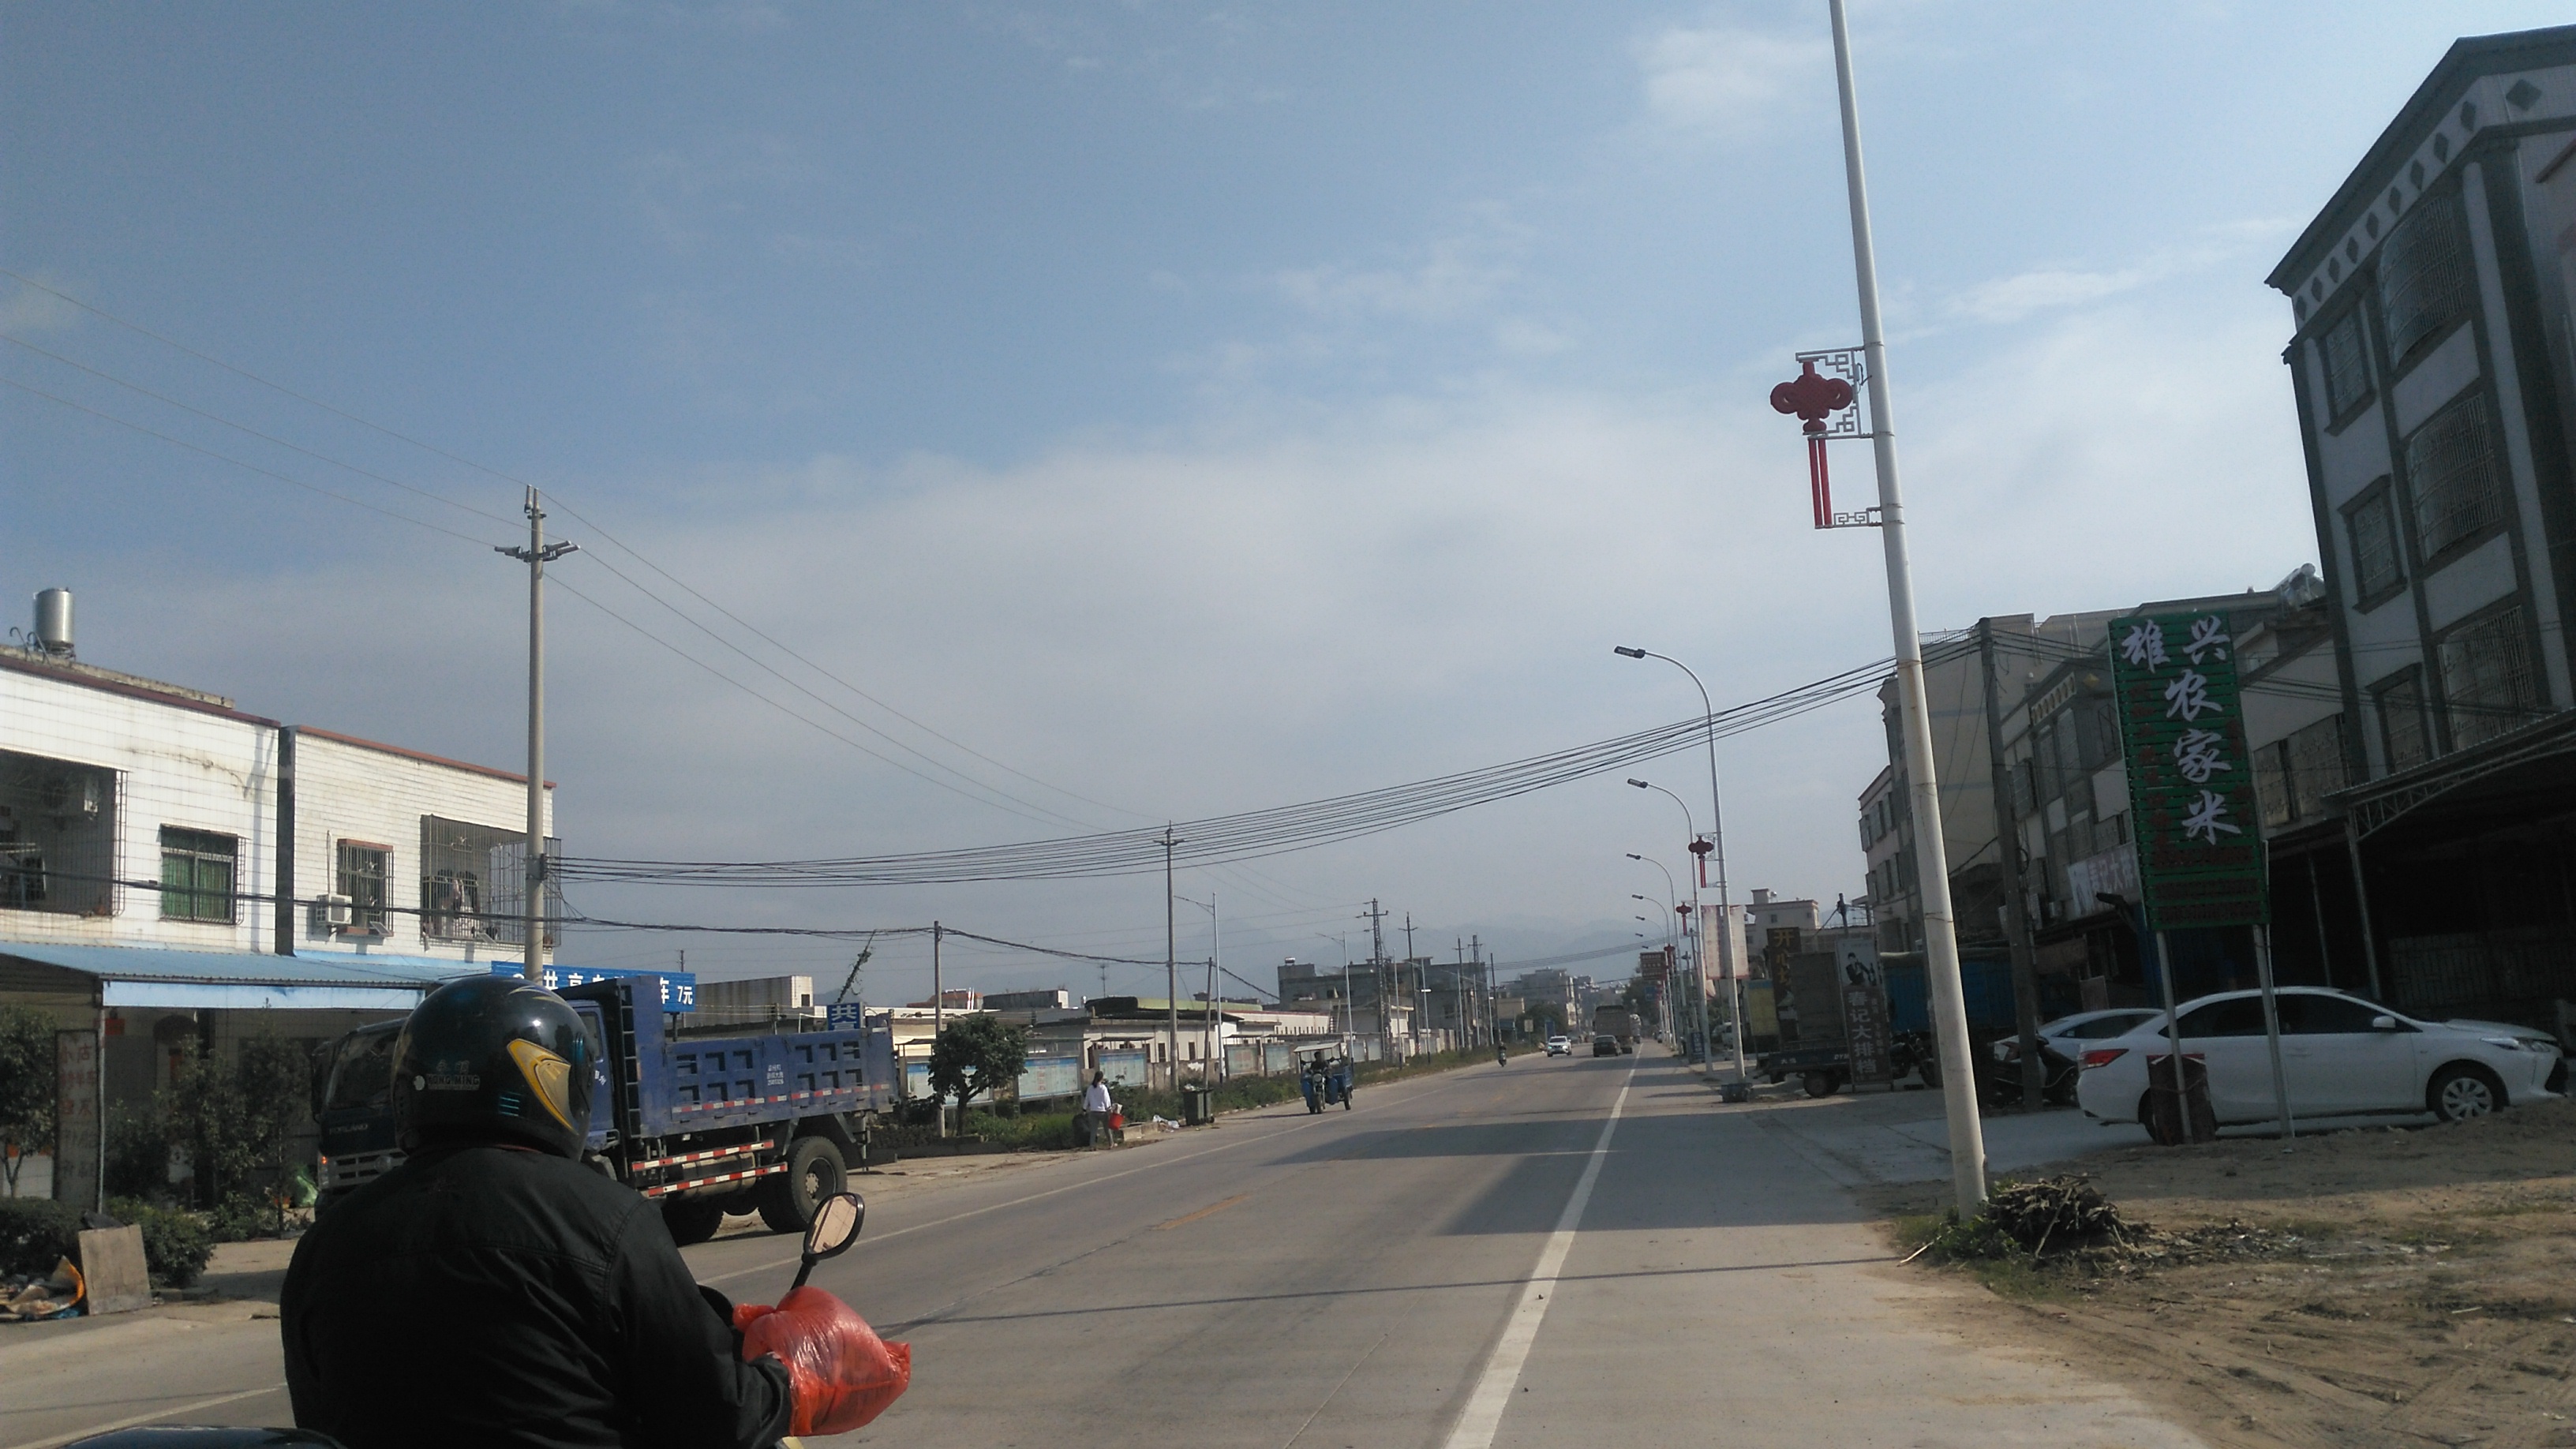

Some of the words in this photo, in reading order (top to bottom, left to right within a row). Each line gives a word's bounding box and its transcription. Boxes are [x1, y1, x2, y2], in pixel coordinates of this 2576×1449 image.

[2164, 668, 2243, 846] 农家米
[1848, 991, 1878, 1075] 春记大排档
